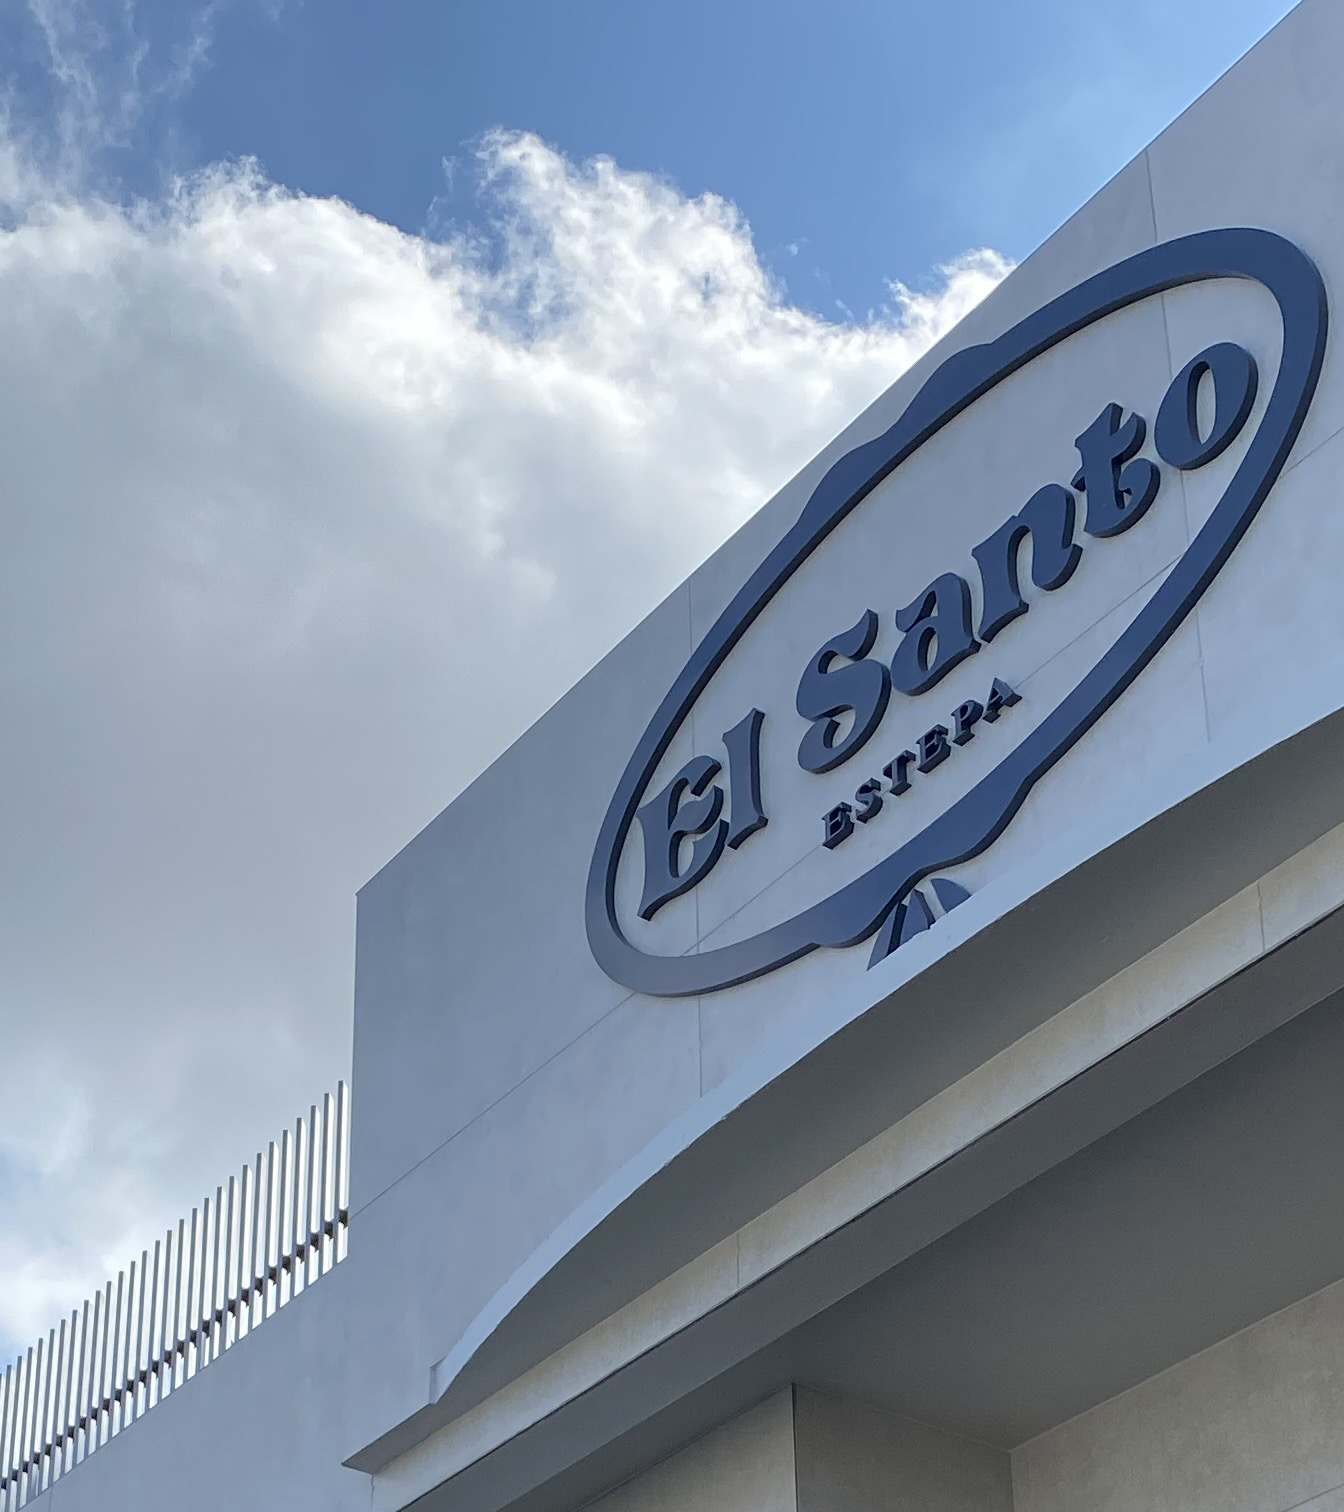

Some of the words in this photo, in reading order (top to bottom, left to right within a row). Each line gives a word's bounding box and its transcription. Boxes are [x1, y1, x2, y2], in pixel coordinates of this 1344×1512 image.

[637, 707, 768, 922] El
[796, 342, 1258, 774] Santo
[822, 677, 1023, 850] ESTEPA
